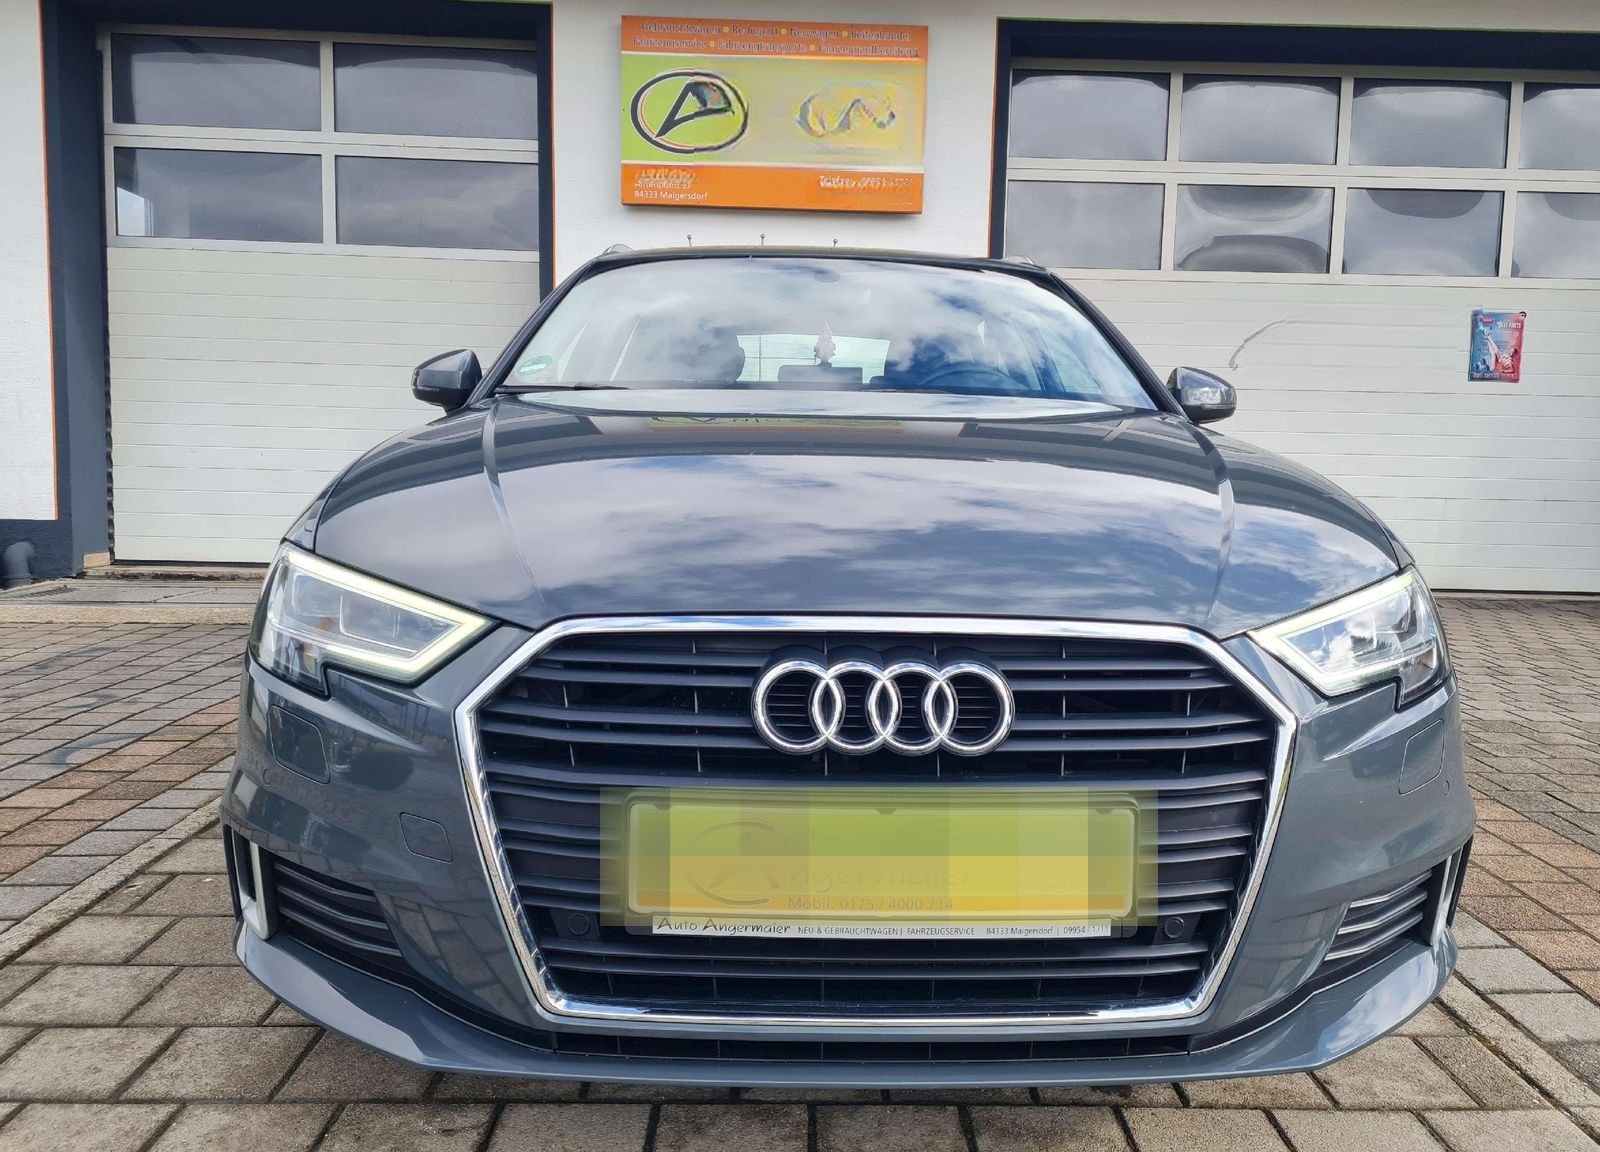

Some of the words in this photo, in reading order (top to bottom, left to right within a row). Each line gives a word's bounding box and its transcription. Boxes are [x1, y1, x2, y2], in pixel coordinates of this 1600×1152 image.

[634, 190, 658, 199] 84333
[839, 898, 874, 910] 0175
[888, 898, 923, 910] 4000
[929, 898, 952, 911] 714
[657, 917, 698, 931] Auto
[702, 918, 790, 935] Angermaier
[824, 926, 898, 935] GEBRAUCHTWAGEN
[907, 927, 975, 936] FAHRZEUGSERVICE
[986, 927, 1009, 935] 84333
